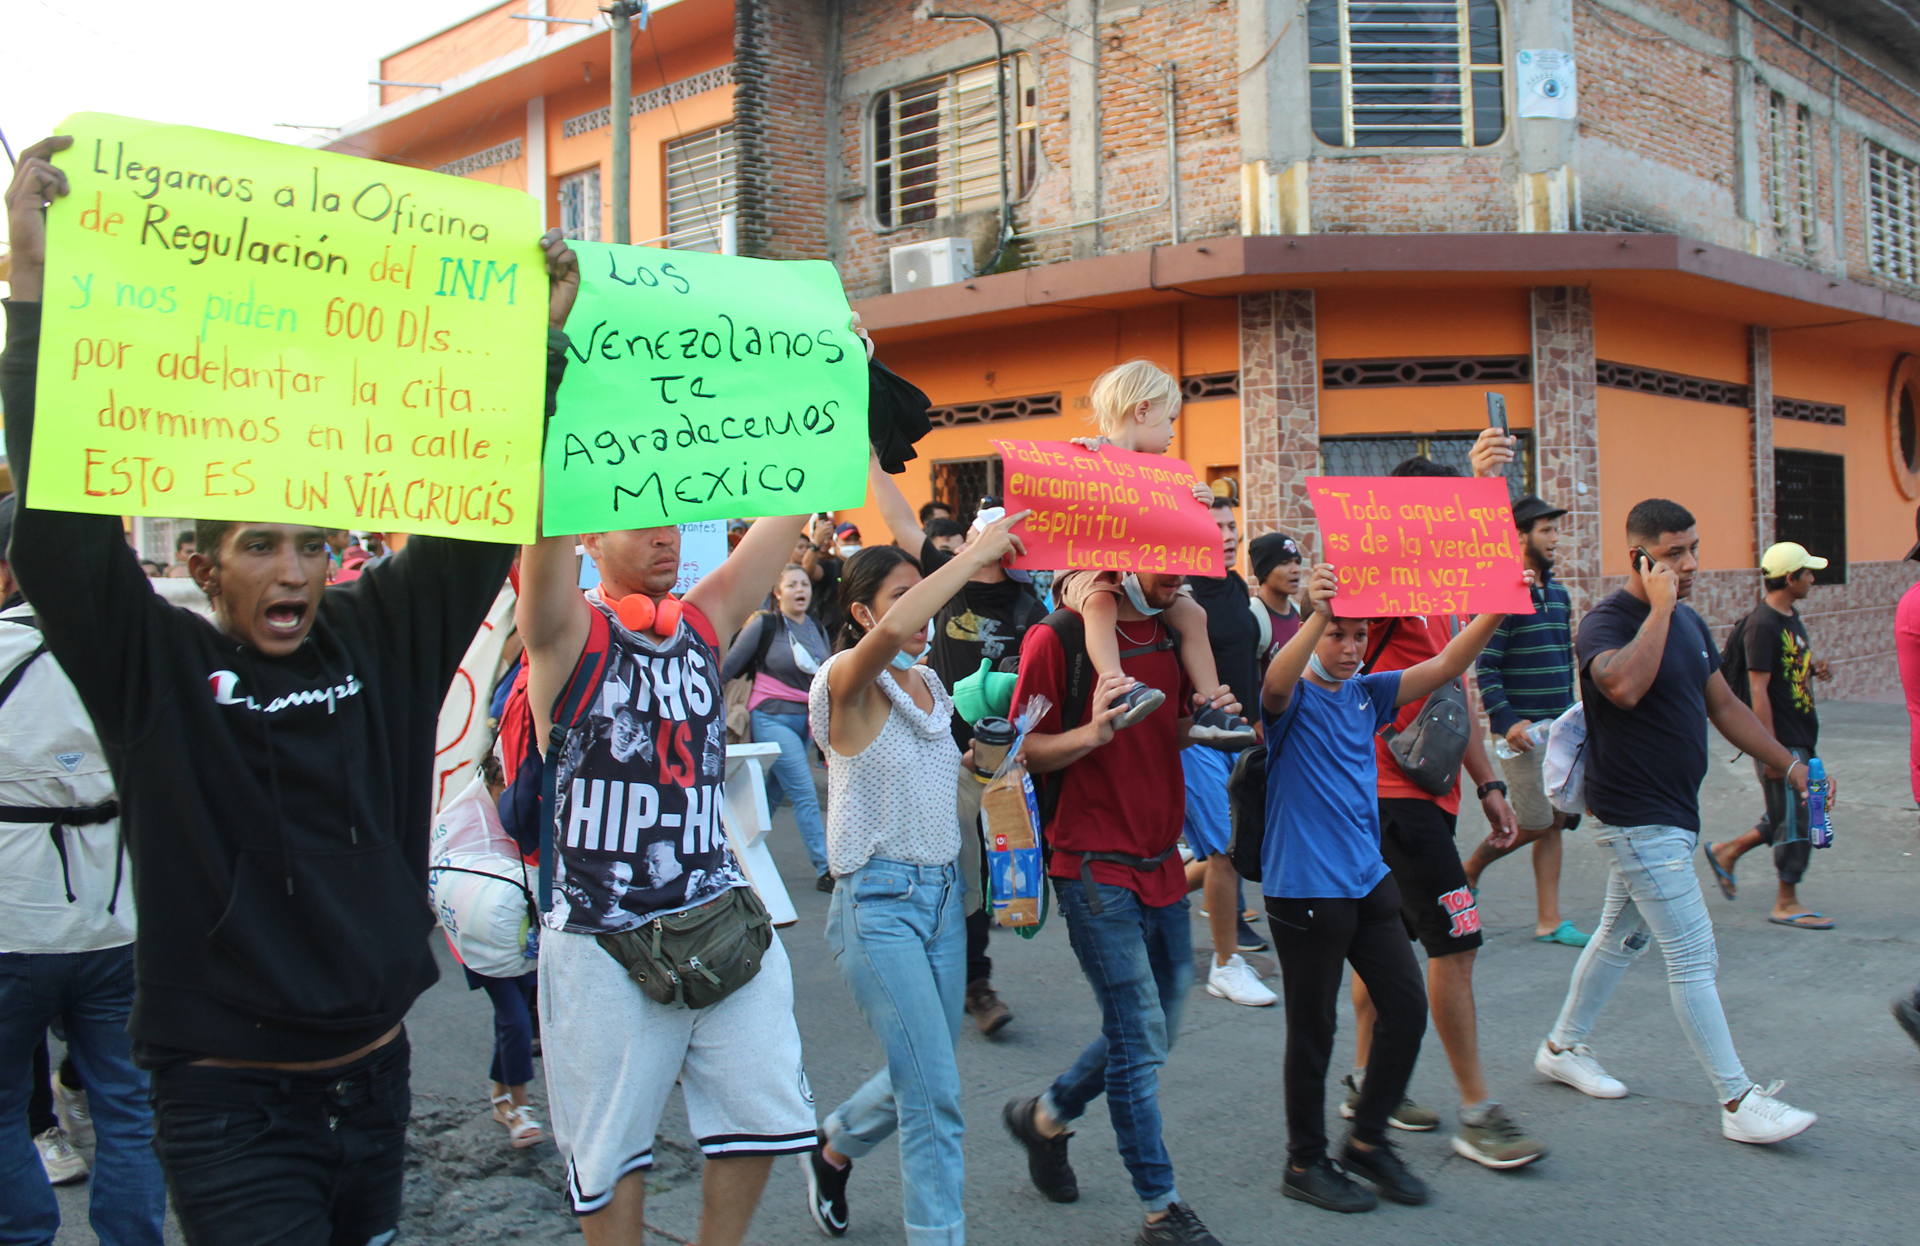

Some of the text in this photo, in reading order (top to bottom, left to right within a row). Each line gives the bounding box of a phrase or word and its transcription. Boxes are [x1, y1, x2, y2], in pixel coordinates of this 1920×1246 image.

[93, 138, 490, 244] Llegamos a la Oficina
[79, 190, 519, 306] de Regulación del INM
[70, 271, 95, 311] y
[115, 278, 178, 314] nos
[199, 279, 299, 343] piden
[323, 296, 386, 345] 600
[566, 313, 845, 365] Venezolanos
[71, 336, 134, 381] por
[156, 335, 328, 400] adelantar
[351, 356, 378, 407] la
[96, 387, 282, 445] dormimos
[307, 422, 345, 452] en
[363, 417, 395, 455] la
[82, 448, 176, 508] ESTO
[203, 459, 257, 498] ES
[284, 471, 329, 511] UN
[1010, 471, 1180, 512] encomiendo mi
[1098, 451, 1136, 479] tus
[1138, 463, 1198, 489] manos
[1328, 531, 1351, 552] es
[1360, 522, 1389, 555] de
[1399, 525, 1422, 558] la
[1400, 492, 1467, 535] aquel
[1468, 505, 1512, 537] que
[1066, 540, 1213, 572] Lucas 23:46
[1339, 565, 1381, 596] oye
[1391, 559, 1422, 588] mi
[632, 648, 713, 721] THIS
[656, 719, 696, 789] IS
